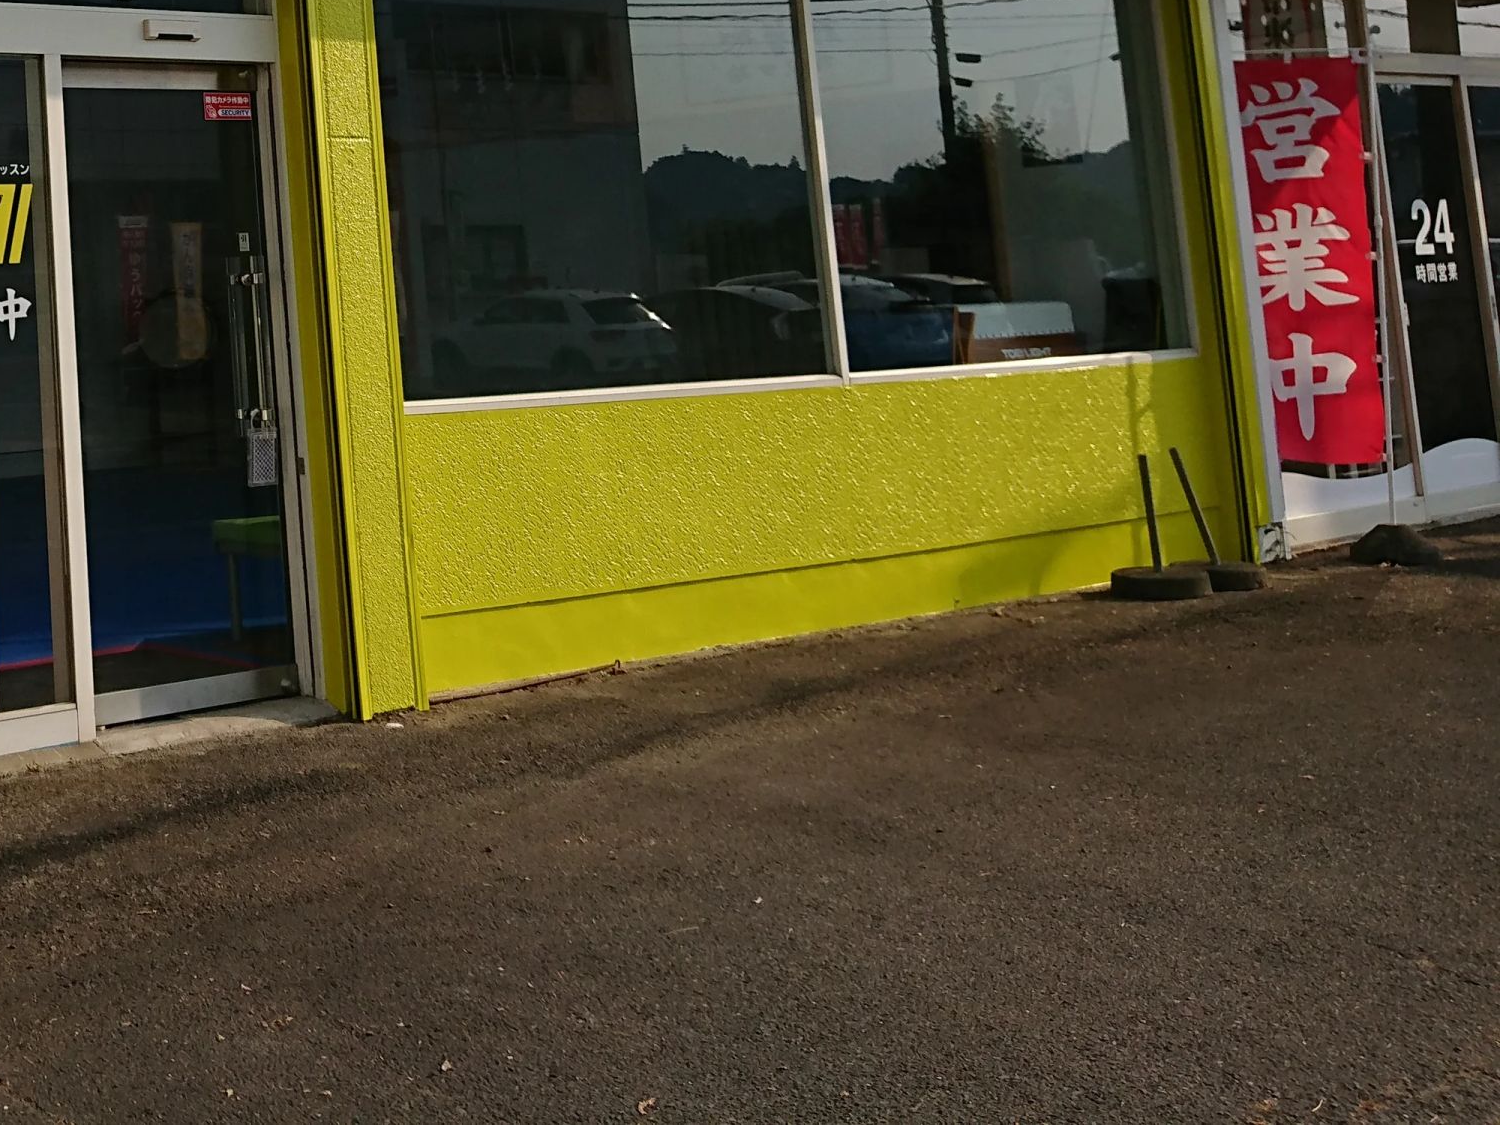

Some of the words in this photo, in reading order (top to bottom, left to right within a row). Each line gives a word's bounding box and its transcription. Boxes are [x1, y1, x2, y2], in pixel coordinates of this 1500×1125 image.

[1241, 77, 1361, 442] 営業中
[1411, 198, 1455, 256] 24
